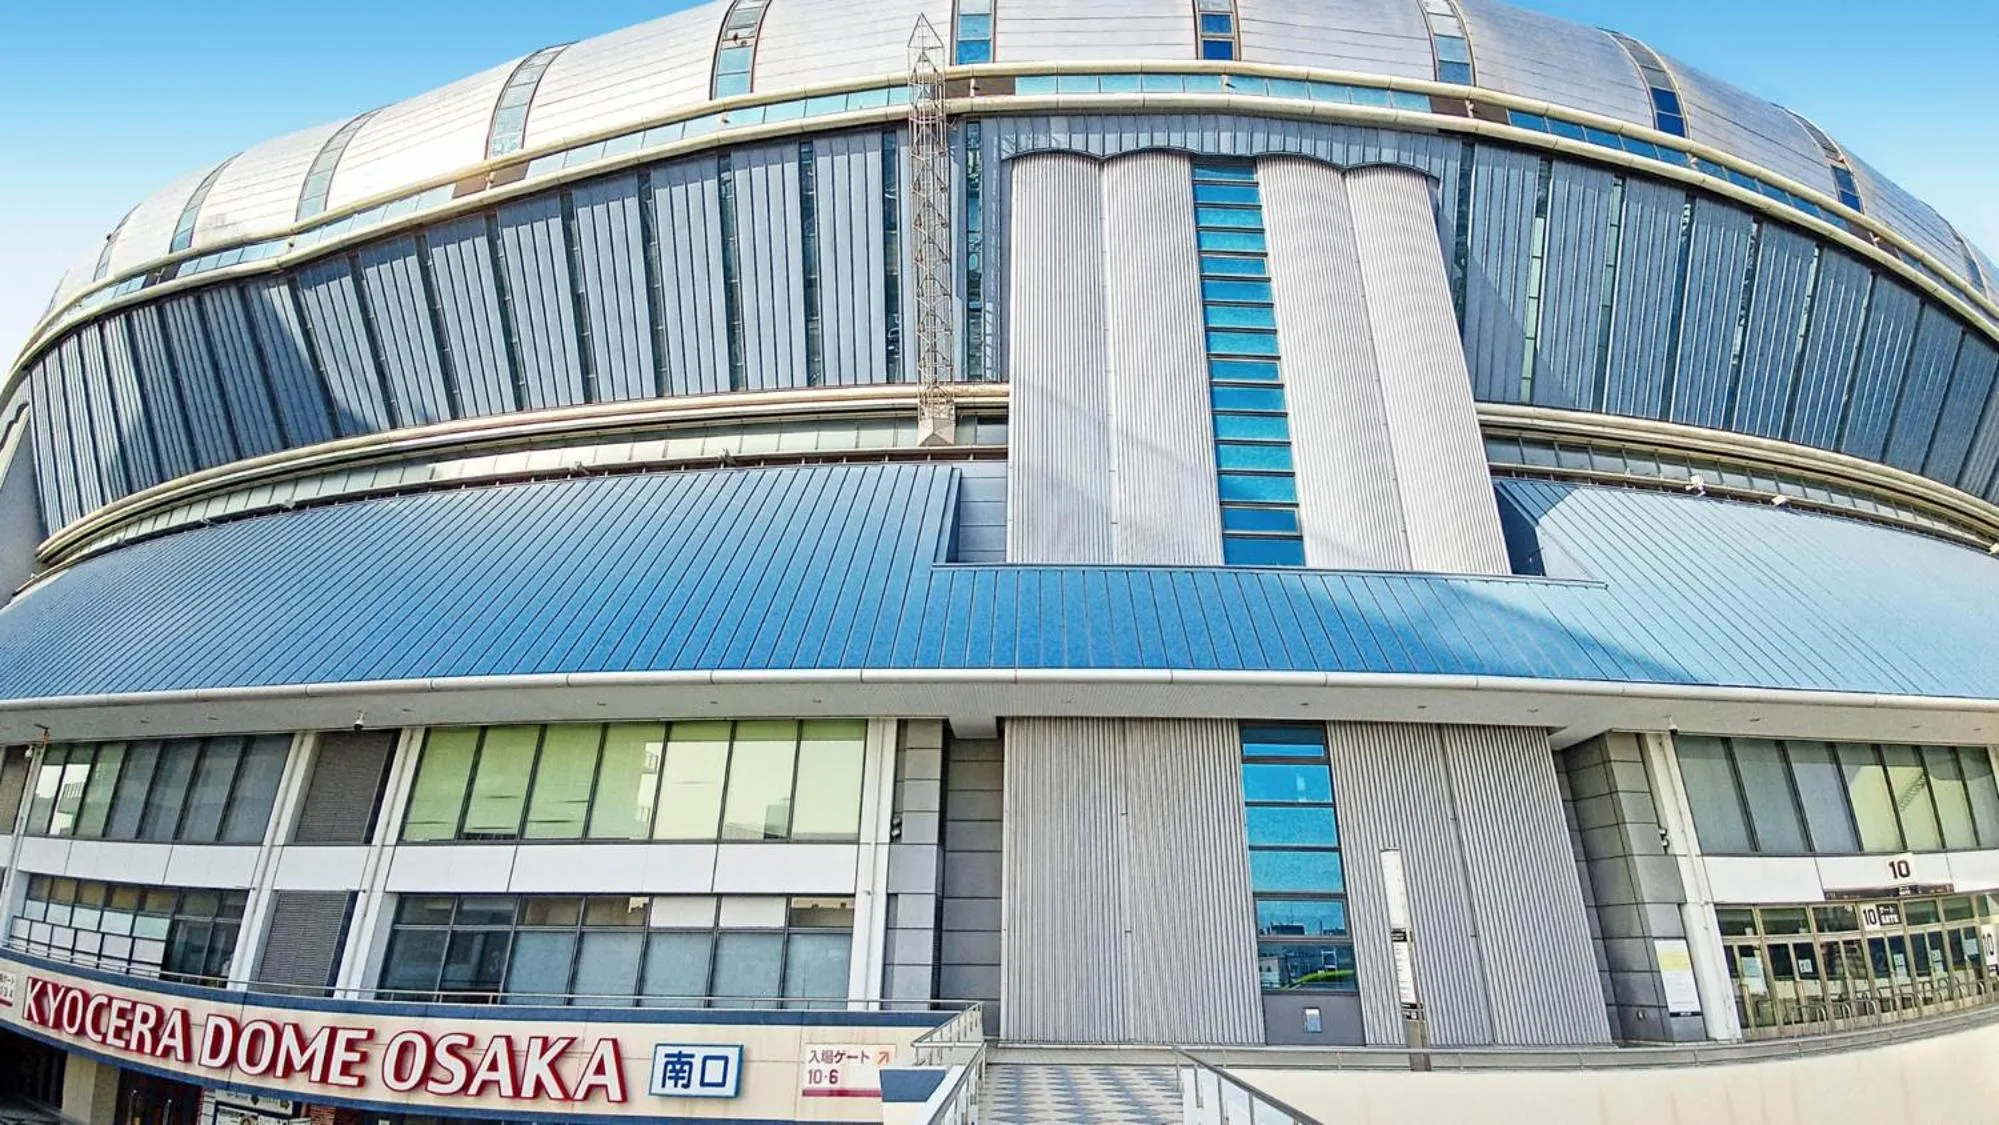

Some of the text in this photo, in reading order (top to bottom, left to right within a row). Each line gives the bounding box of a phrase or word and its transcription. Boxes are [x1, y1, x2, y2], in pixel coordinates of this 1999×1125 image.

[1888, 859, 1911, 879] 10
[1863, 908, 1877, 926] 10
[1982, 932, 1995, 957] 10
[22, 976, 627, 1103] KYOCERA DOME OSAKA
[808, 1049, 870, 1064] 入場ゲート
[661, 1049, 729, 1089] 南口
